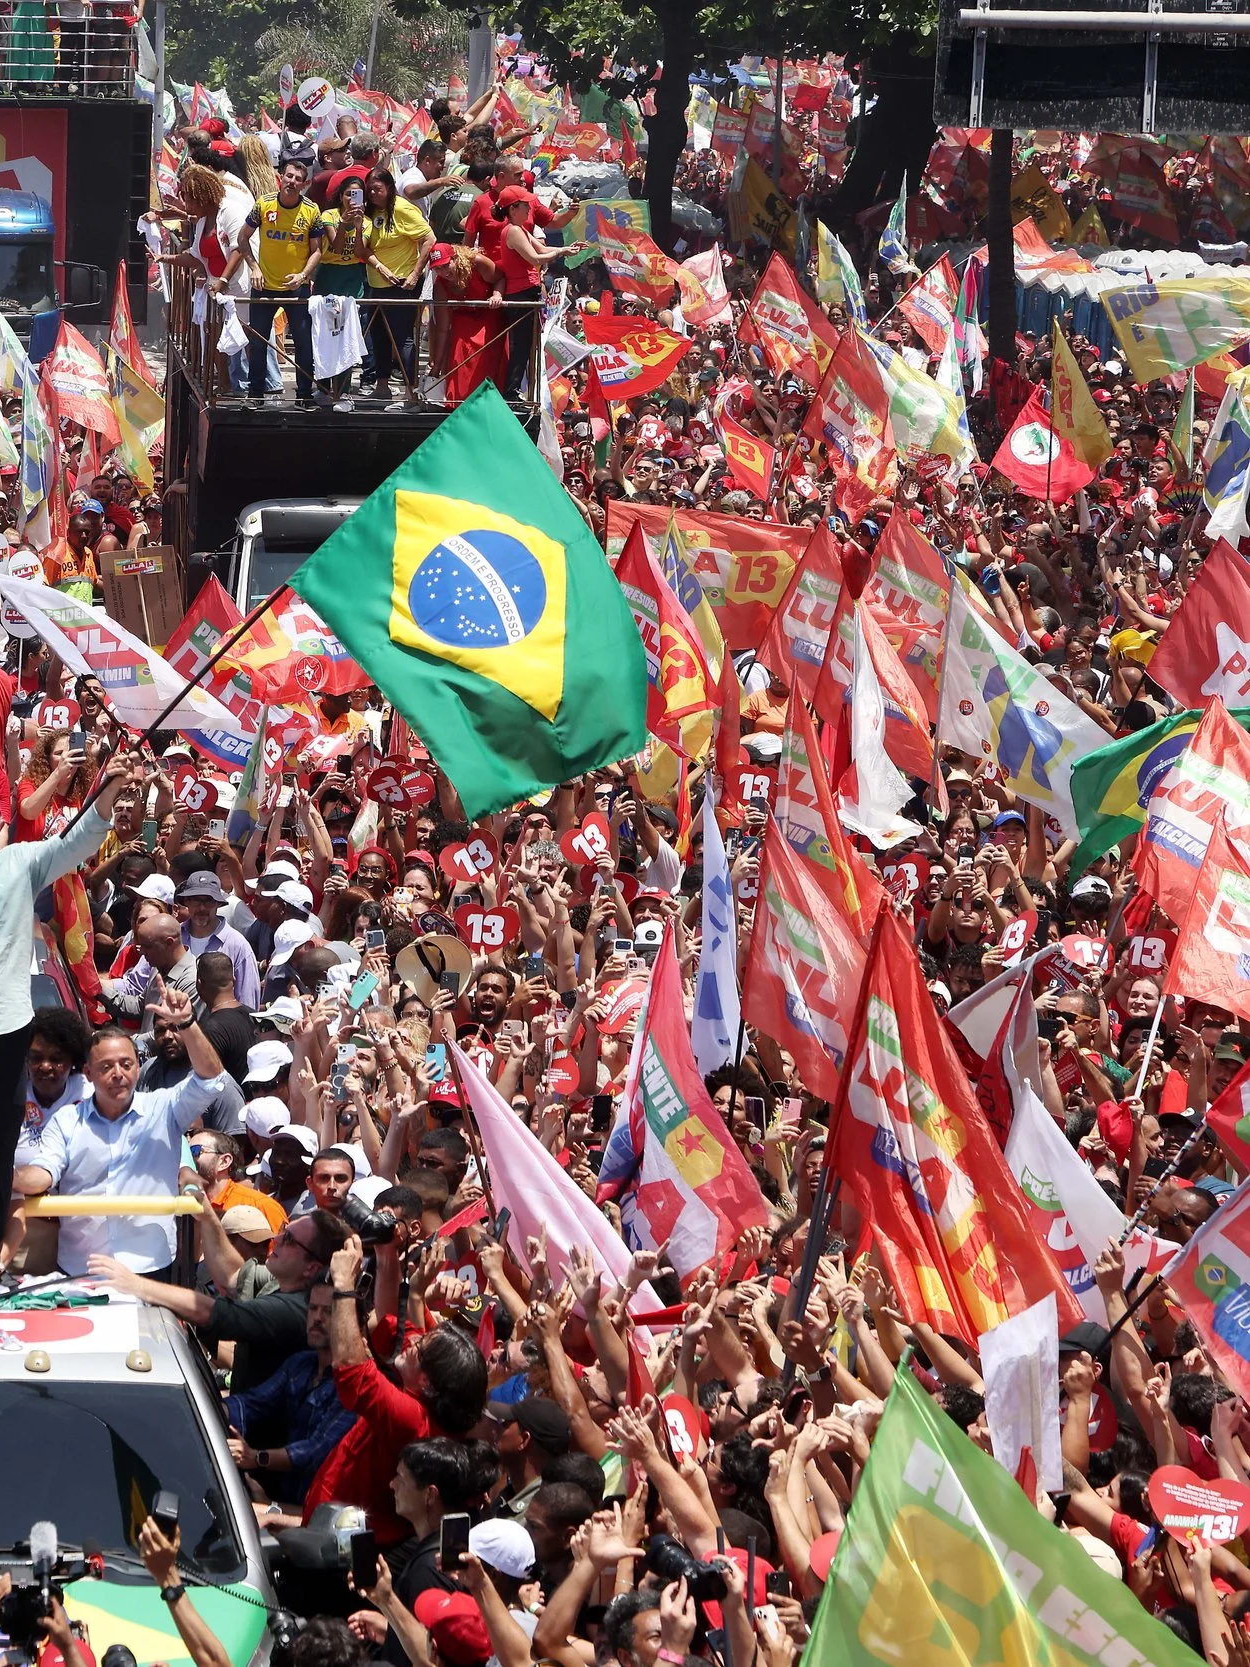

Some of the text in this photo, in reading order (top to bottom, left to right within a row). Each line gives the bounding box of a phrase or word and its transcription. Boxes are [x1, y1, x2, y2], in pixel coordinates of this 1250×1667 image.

[302, 79, 329, 111] LULA 13
[267, 211, 278, 223] 13
[648, 256, 669, 278] 13
[1109, 283, 1160, 323] RIO
[755, 302, 809, 342] LULA
[627, 331, 665, 357] 13
[52, 358, 107, 388] LULA
[595, 350, 629, 372] ULA
[640, 421, 658, 439] 13
[726, 435, 756, 463] 13
[11, 564, 35, 580] LULA
[122, 560, 155, 575] LULA 13
[732, 556, 778, 594] 13
[449, 538, 521, 639] ORDEM E PROGRESSO
[96, 666, 132, 682] KMIN
[43, 705, 70, 729] 13
[203, 727, 249, 759] ALCK
[264, 737, 282, 766] 13
[179, 775, 209, 810] 13
[372, 775, 405, 804] 13
[739, 772, 770, 801] 13
[572, 823, 609, 861] 13
[453, 839, 494, 878] 13
[883, 862, 918, 891] 13
[466, 913, 505, 946] 13
[1000, 919, 1028, 950] 13
[1073, 939, 1110, 972] 13
[1129, 936, 1166, 970] 13
[435, 1083, 457, 1095] LULA
[1164, 1513, 1240, 1543] AMANHÃ 13!
